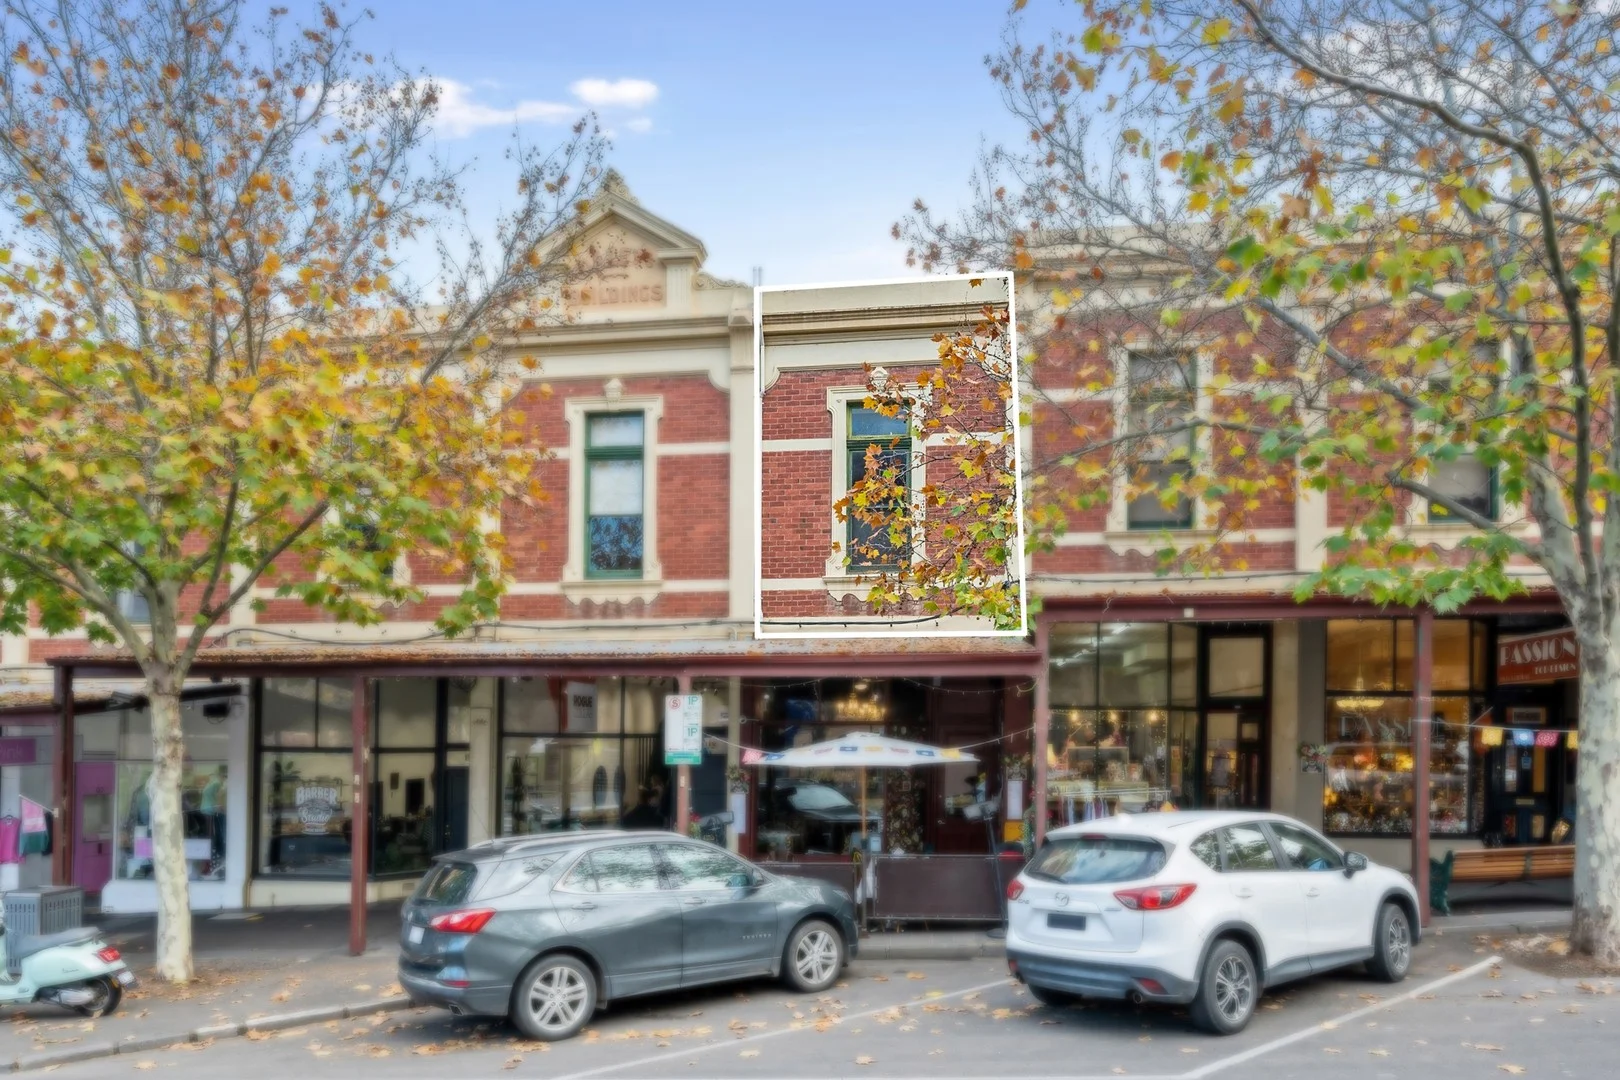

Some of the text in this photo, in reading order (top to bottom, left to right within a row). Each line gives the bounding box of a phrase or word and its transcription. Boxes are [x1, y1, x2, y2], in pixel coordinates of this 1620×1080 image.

[1500, 637, 1576, 666] PASSION
[687, 696, 698, 705] 1P
[687, 727, 698, 737] 1P
[1340, 716, 1453, 737] PASSIN
[295, 786, 337, 805] BARBER
